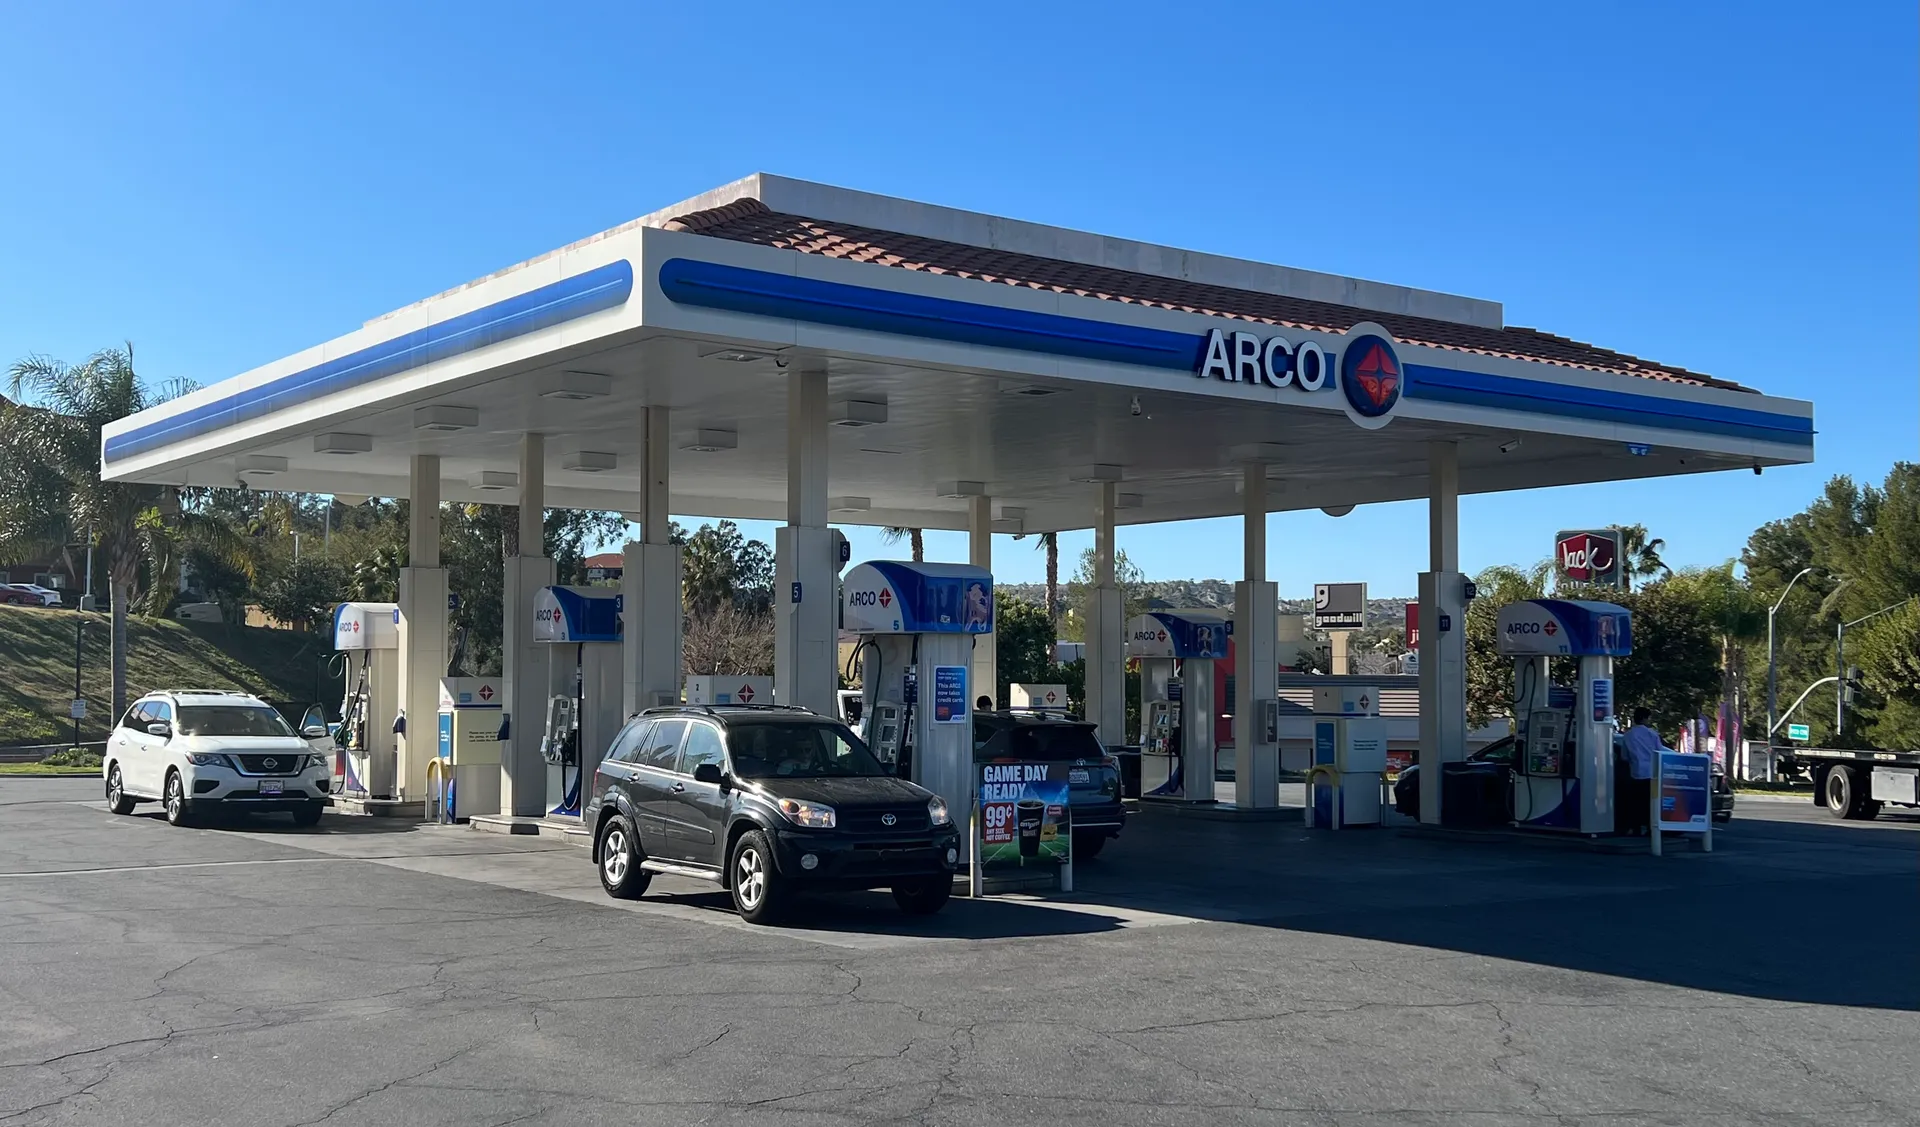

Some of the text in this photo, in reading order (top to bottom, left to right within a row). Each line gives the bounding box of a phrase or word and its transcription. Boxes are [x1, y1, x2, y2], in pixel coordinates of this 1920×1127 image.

[1200, 328, 1327, 392] ARCO
[842, 545, 848, 557] 6
[1562, 538, 1613, 571] Jack
[793, 586, 799, 598] 5
[1466, 586, 1475, 596] 12
[616, 597, 621, 609] 3
[849, 591, 876, 607] ARCO
[535, 609, 552, 622] ARCO
[1315, 613, 1363, 627] goodwill
[893, 620, 900, 631] 5
[1226, 623, 1231, 633] 9
[1441, 618, 1449, 628] 11
[1506, 622, 1541, 635] ARCO
[560, 632, 566, 640] 3
[1133, 630, 1156, 641] ARCO
[1558, 645, 1568, 653] 11
[695, 683, 700, 692] 2
[984, 765, 1022, 783] GAME
[1024, 764, 1049, 782] DAY
[984, 782, 1026, 801] READY
[995, 833, 1011, 841] COFFEE
